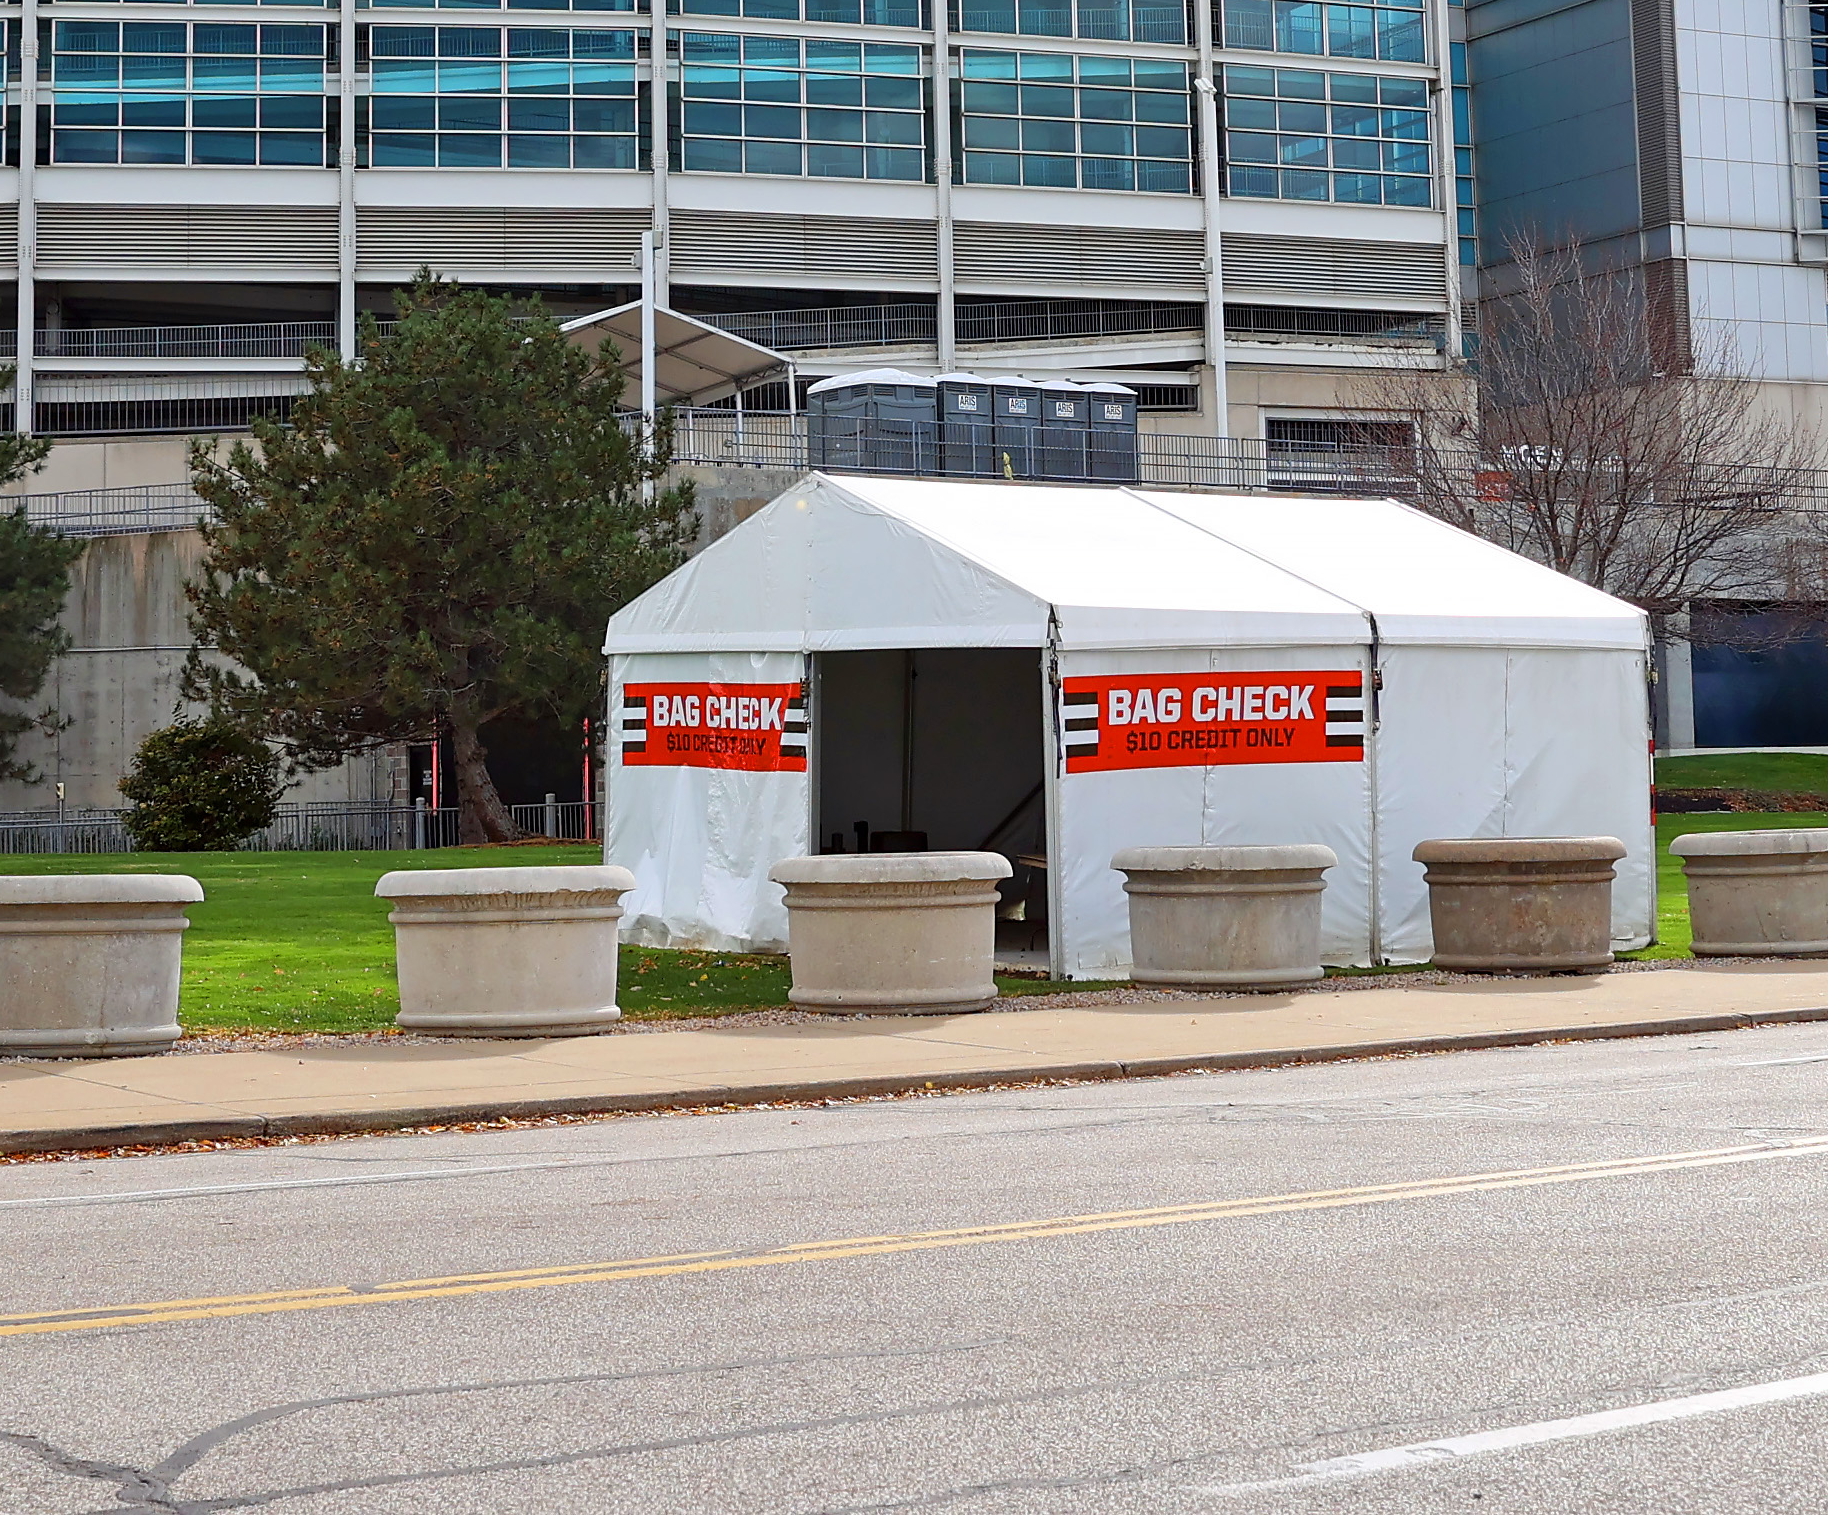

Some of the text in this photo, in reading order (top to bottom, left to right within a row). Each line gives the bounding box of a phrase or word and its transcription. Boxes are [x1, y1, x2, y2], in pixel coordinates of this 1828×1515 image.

[653, 695, 783, 731] BAG CHECK
[1108, 684, 1315, 726] BAG CHECK
[667, 732, 691, 754] $10
[693, 733, 738, 754] CREDIT
[1126, 727, 1296, 754] $10 CREDIT ONLY
